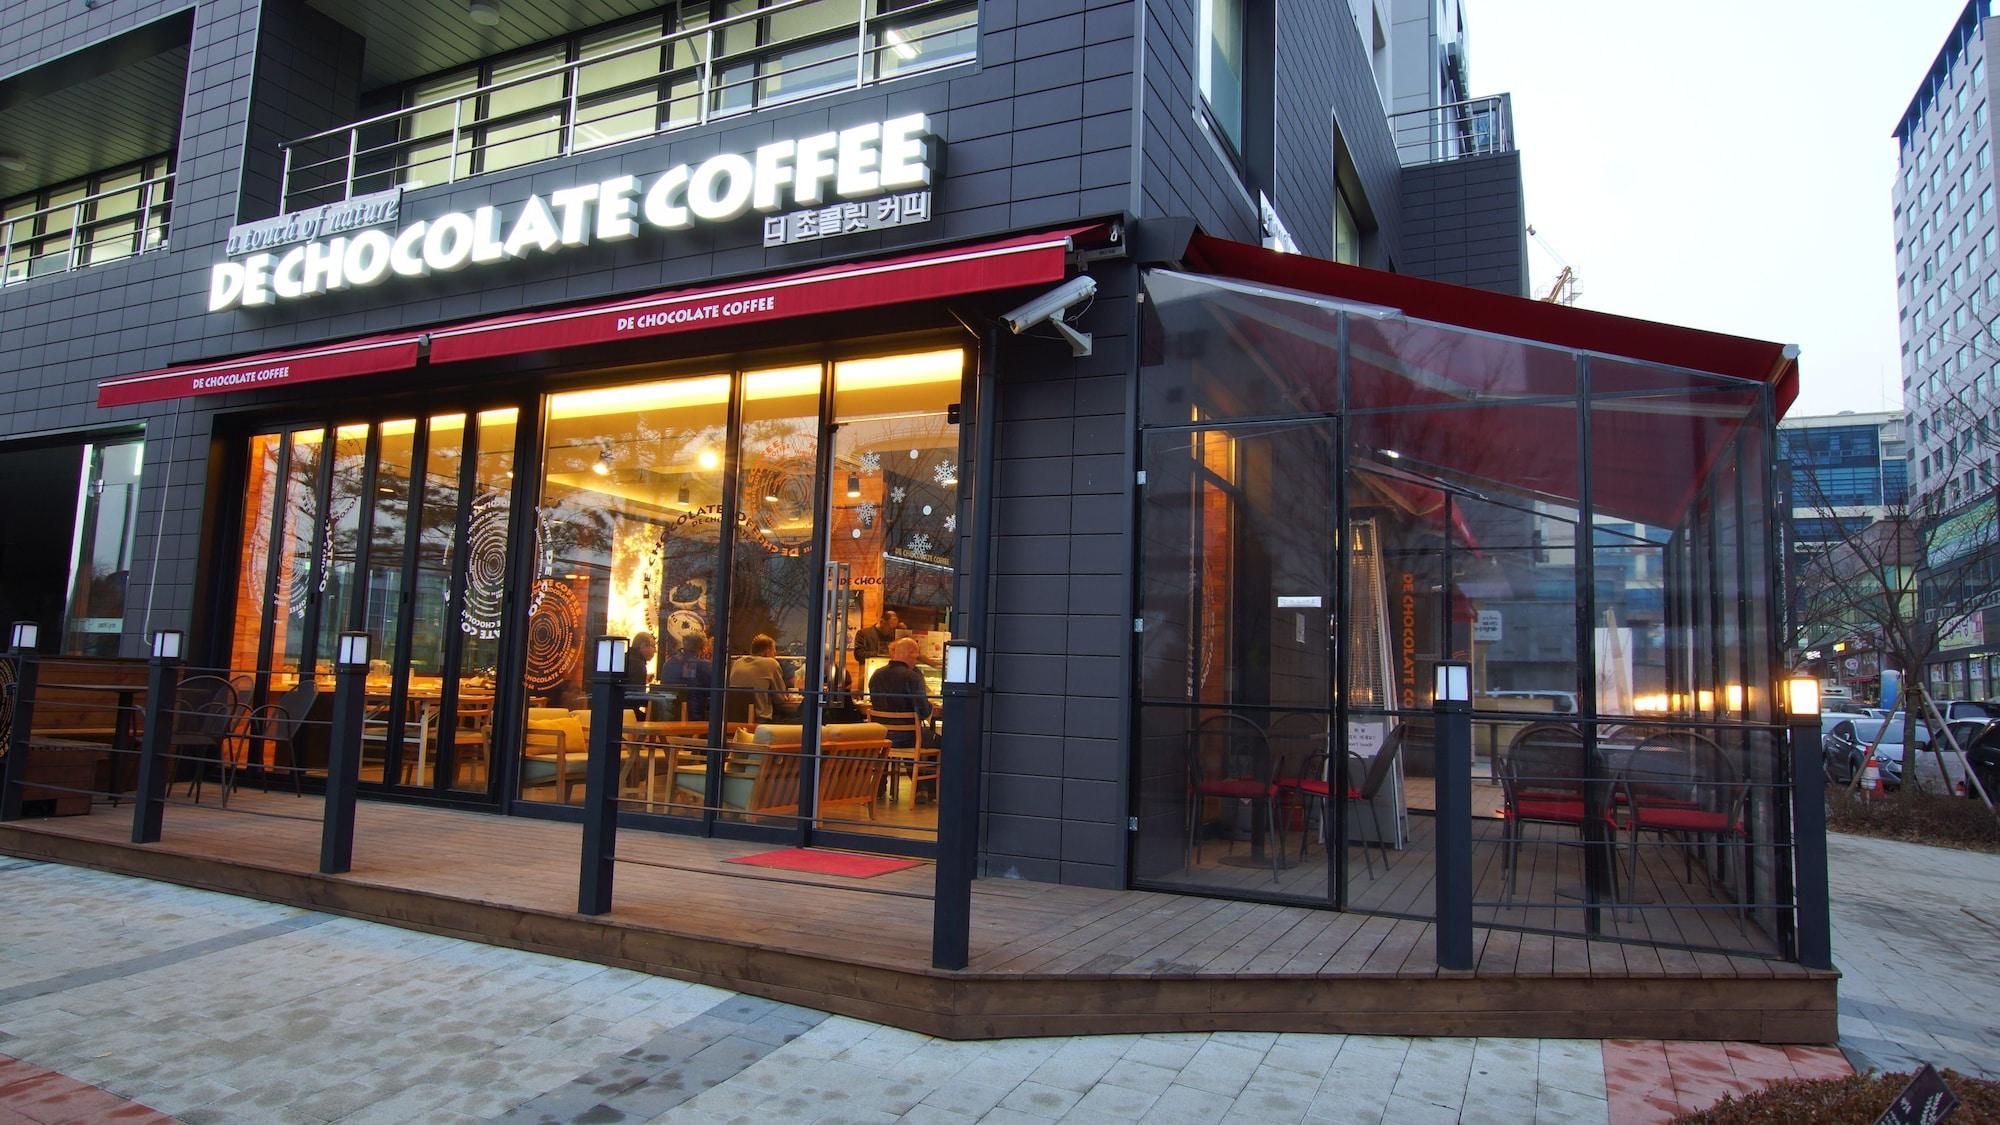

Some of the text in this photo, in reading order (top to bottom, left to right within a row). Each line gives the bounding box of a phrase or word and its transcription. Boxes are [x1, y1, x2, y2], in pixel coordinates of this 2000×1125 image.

[209, 112, 931, 312] DE CHOCOLATE COFFEE
[226, 196, 399, 255] a touch of nature
[765, 191, 931, 242] 디 초콜릿 커피
[617, 296, 775, 331] DE CHOCOLATE COFFEE
[192, 366, 290, 389] DE CHOCOLATE COFFEE
[1403, 573, 1415, 592] DE
[1403, 595, 1415, 685] CHOCOLATE
